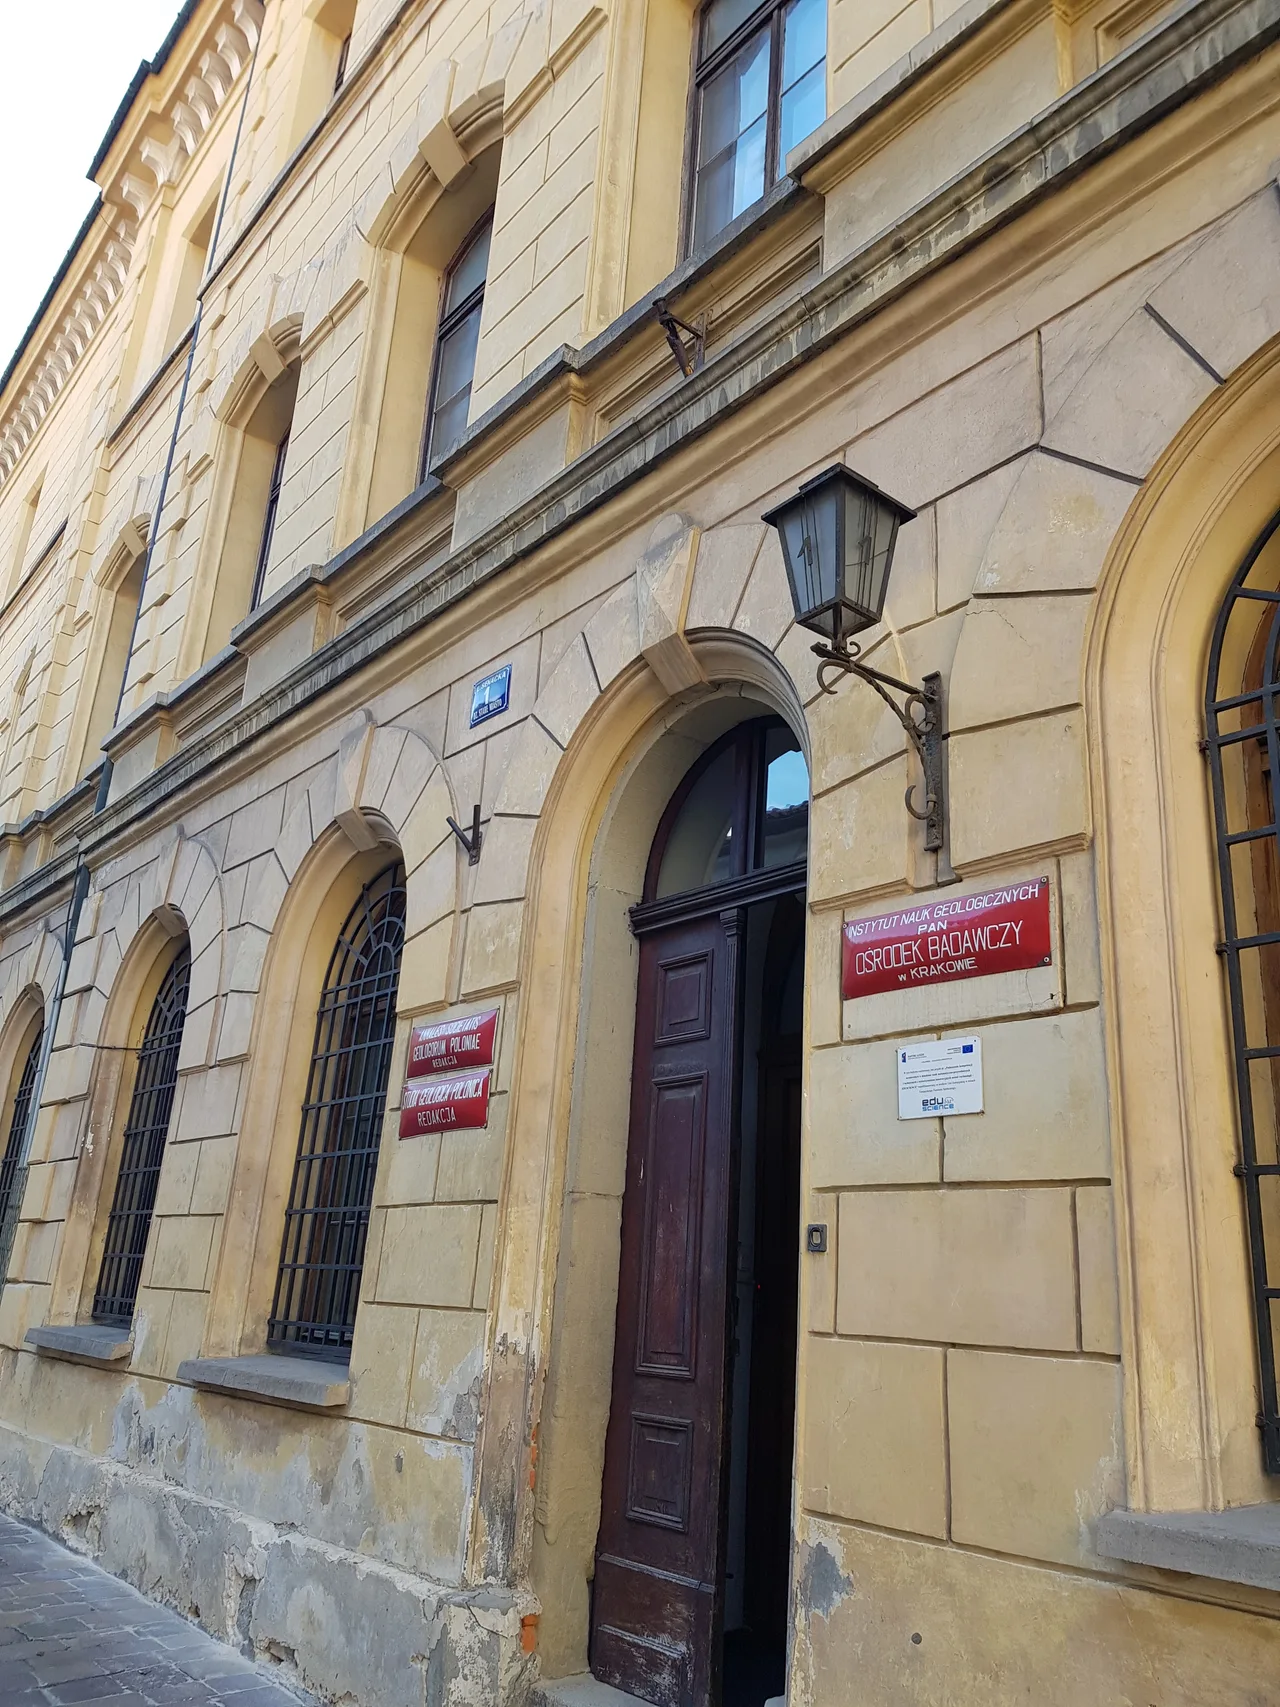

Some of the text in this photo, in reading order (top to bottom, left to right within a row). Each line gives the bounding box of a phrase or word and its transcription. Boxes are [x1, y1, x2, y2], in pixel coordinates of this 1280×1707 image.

[484, 686, 490, 705] 1
[848, 883, 1039, 938] INSTYTUT NAUK GEOLOGICZNYCH
[917, 920, 947, 935] PAN
[855, 920, 1023, 975] OŚRODEK BADAWCZY
[897, 957, 978, 982] w KRAKOWIE
[413, 1033, 481, 1062] GEOLOGORUM POLONIAE
[432, 1055, 458, 1068] REDAKCJA
[450, 1078, 484, 1101] POLONICA
[922, 1097, 944, 1106] edu
[417, 1106, 457, 1127] REDAKCJA
